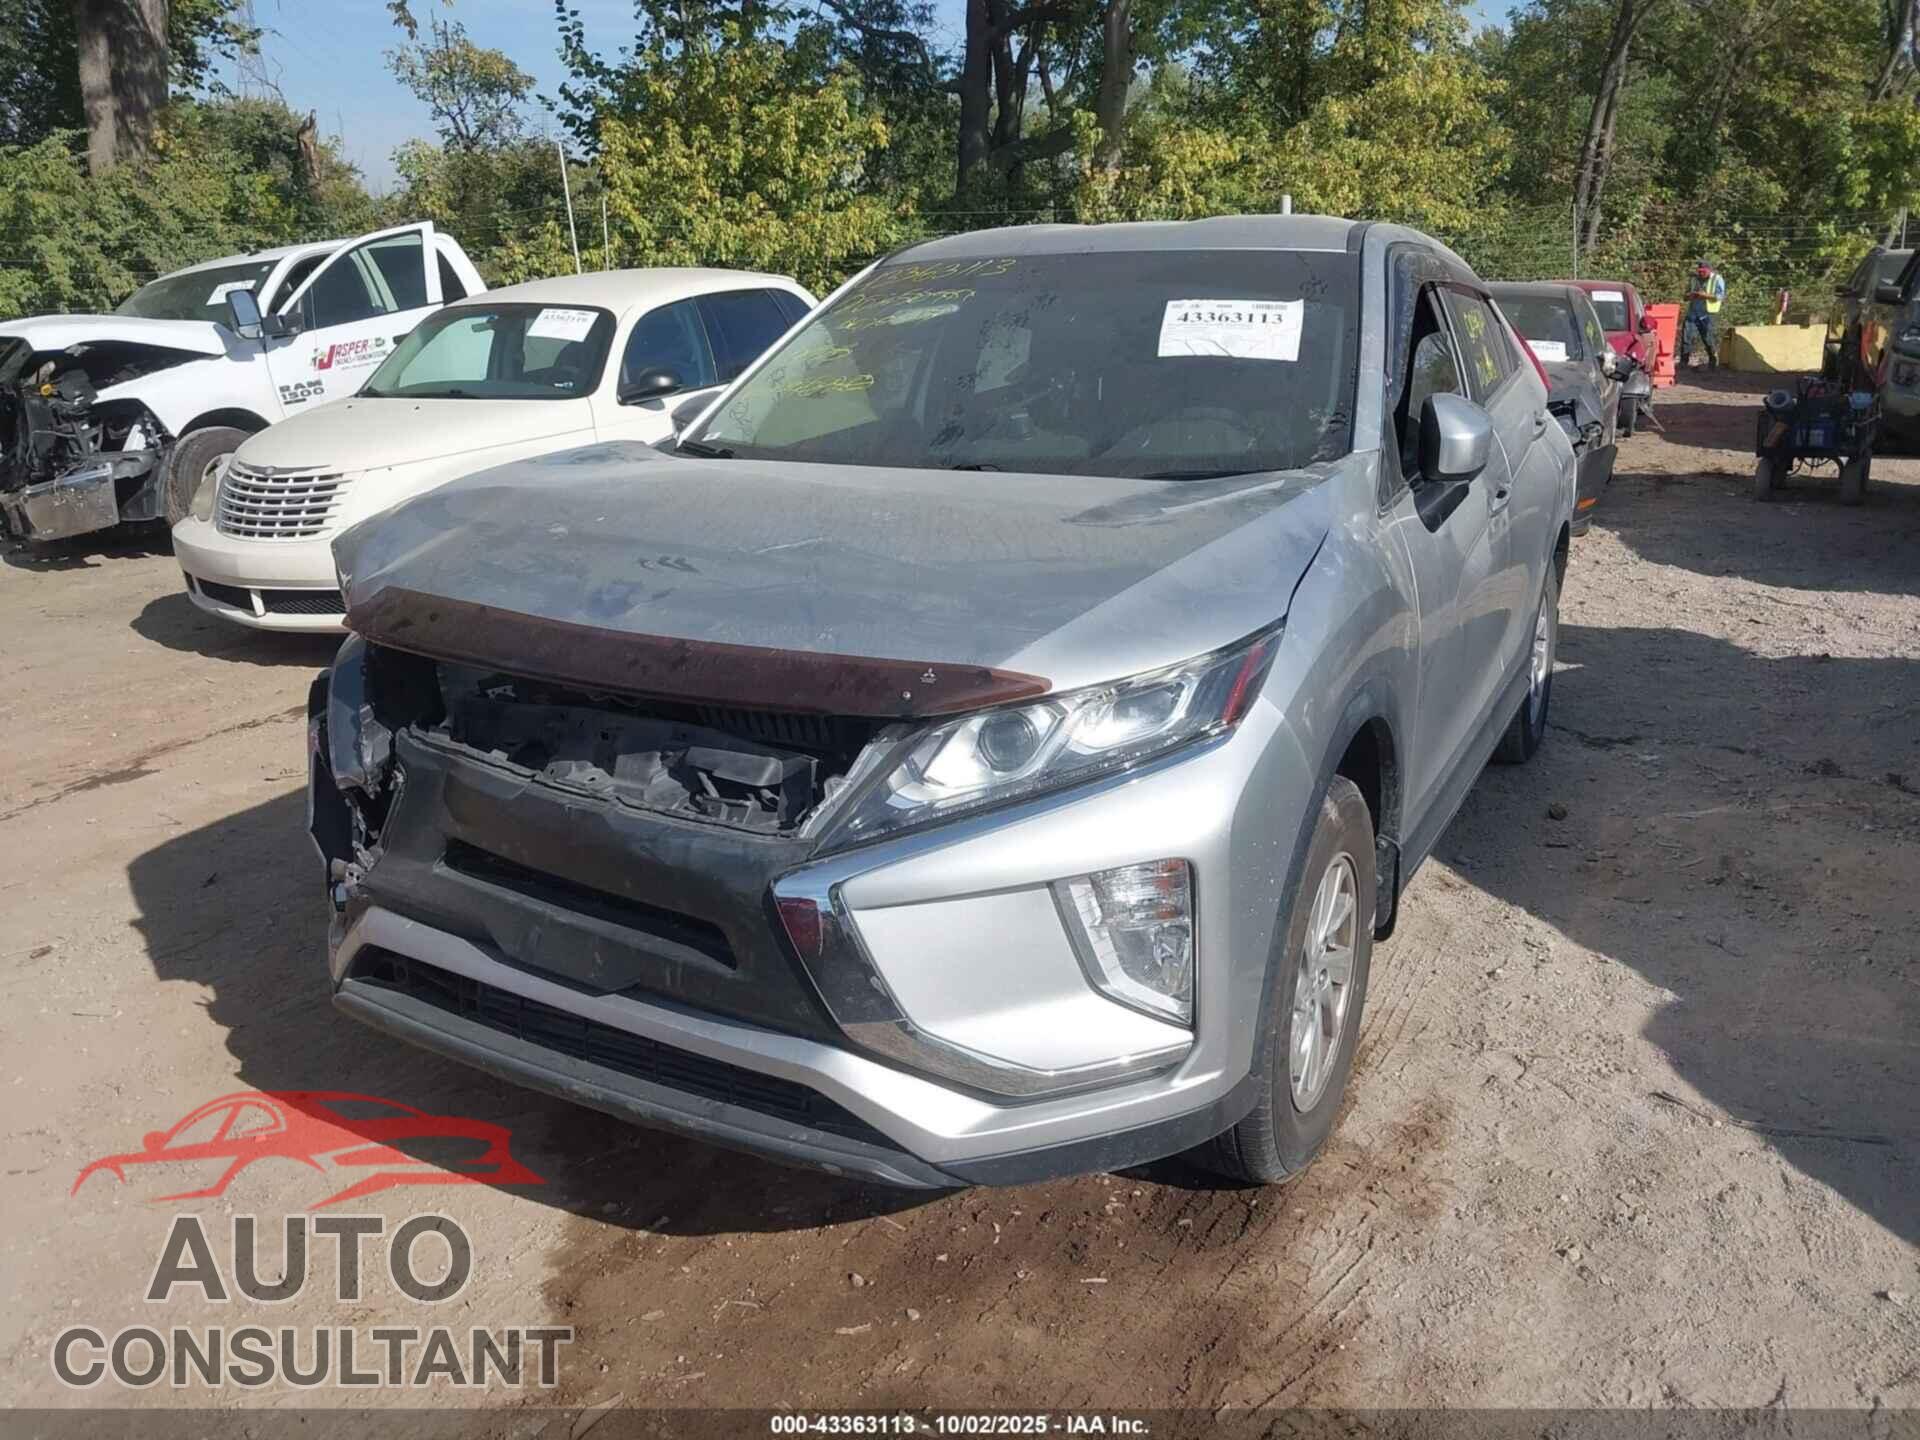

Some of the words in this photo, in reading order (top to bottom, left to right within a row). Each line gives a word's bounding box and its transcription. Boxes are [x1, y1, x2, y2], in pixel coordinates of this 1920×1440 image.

[1177, 311, 1283, 324] 43363113
[317, 339, 369, 370] JASPER
[279, 379, 323, 393] RAM
[280, 386, 325, 401] 1500
